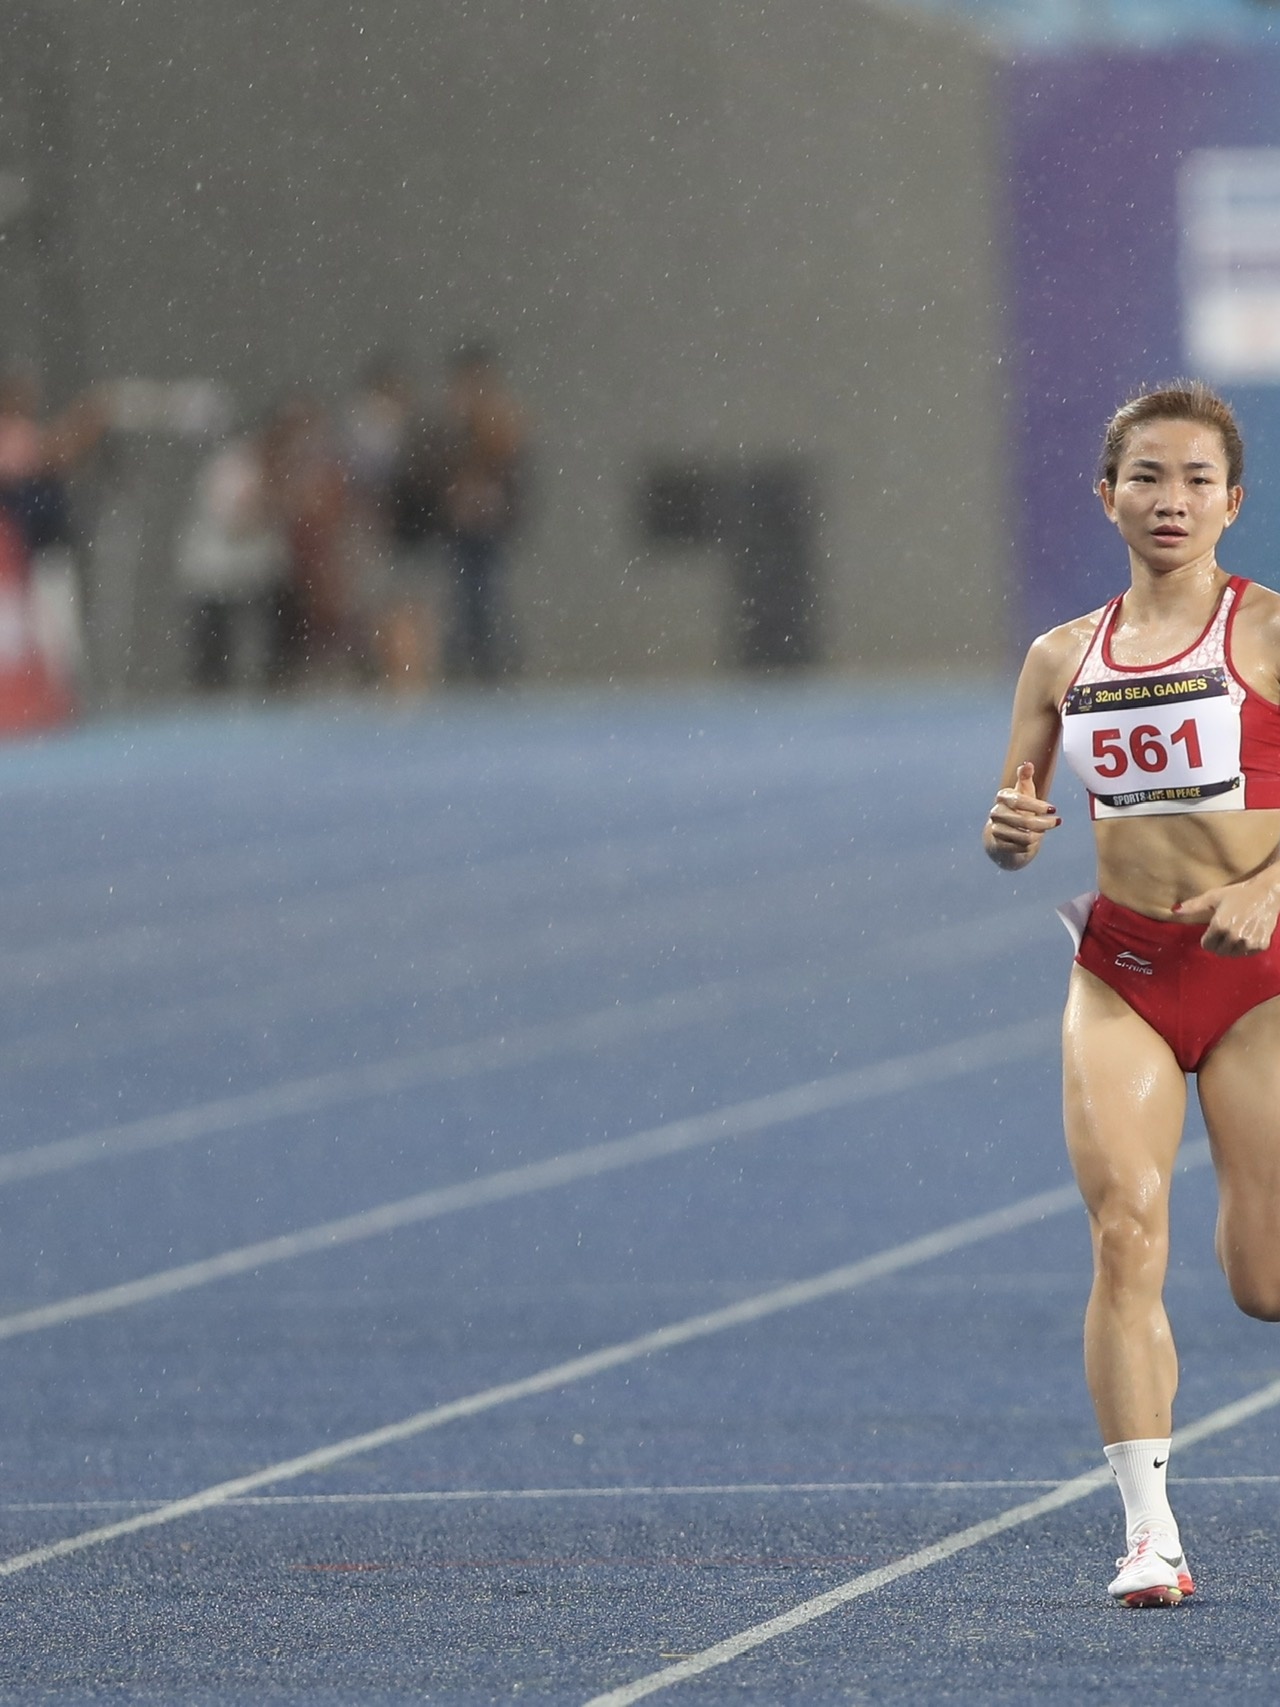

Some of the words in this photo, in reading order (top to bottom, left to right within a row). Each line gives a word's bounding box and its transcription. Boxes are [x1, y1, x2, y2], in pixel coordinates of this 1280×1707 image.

[1095, 689, 1122, 703] 32nd
[1125, 687, 1151, 700] SEA
[1154, 678, 1208, 697] GAMES
[1092, 718, 1203, 778] 561
[1176, 787, 1201, 798] PEACE
